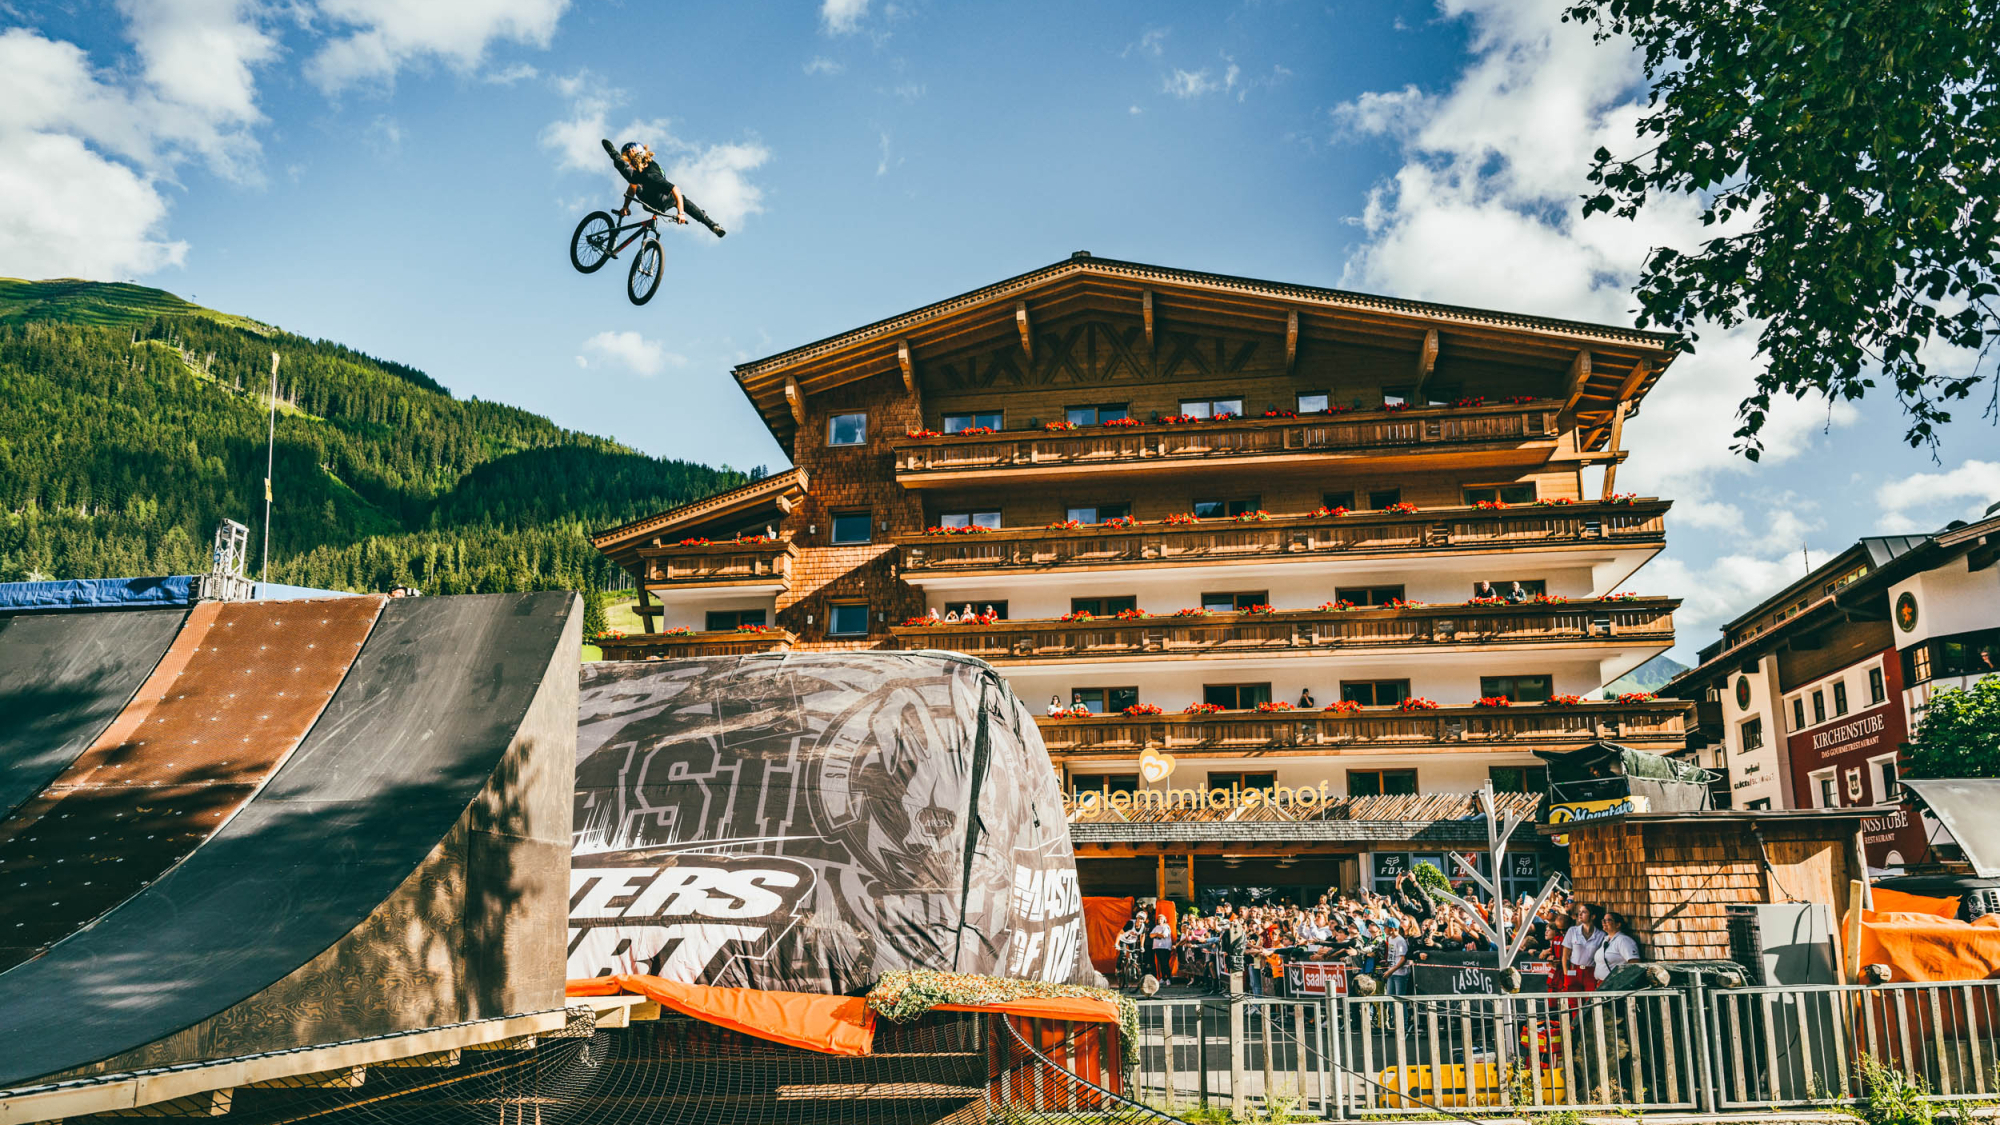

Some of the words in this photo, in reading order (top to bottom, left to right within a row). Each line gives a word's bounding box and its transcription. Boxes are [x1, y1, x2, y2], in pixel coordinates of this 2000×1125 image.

[1812, 713, 1885, 750] KIRCHENSTUBE
[825, 733, 860, 779] SINCE
[1821, 749, 1831, 759] DAS
[1079, 779, 1329, 818] glemmtalerhof
[1381, 866, 1404, 875] FOX
[1516, 867, 1534, 875] FOX
[1010, 928, 1045, 977] OF
[1452, 968, 1493, 995] LÄSSIG
